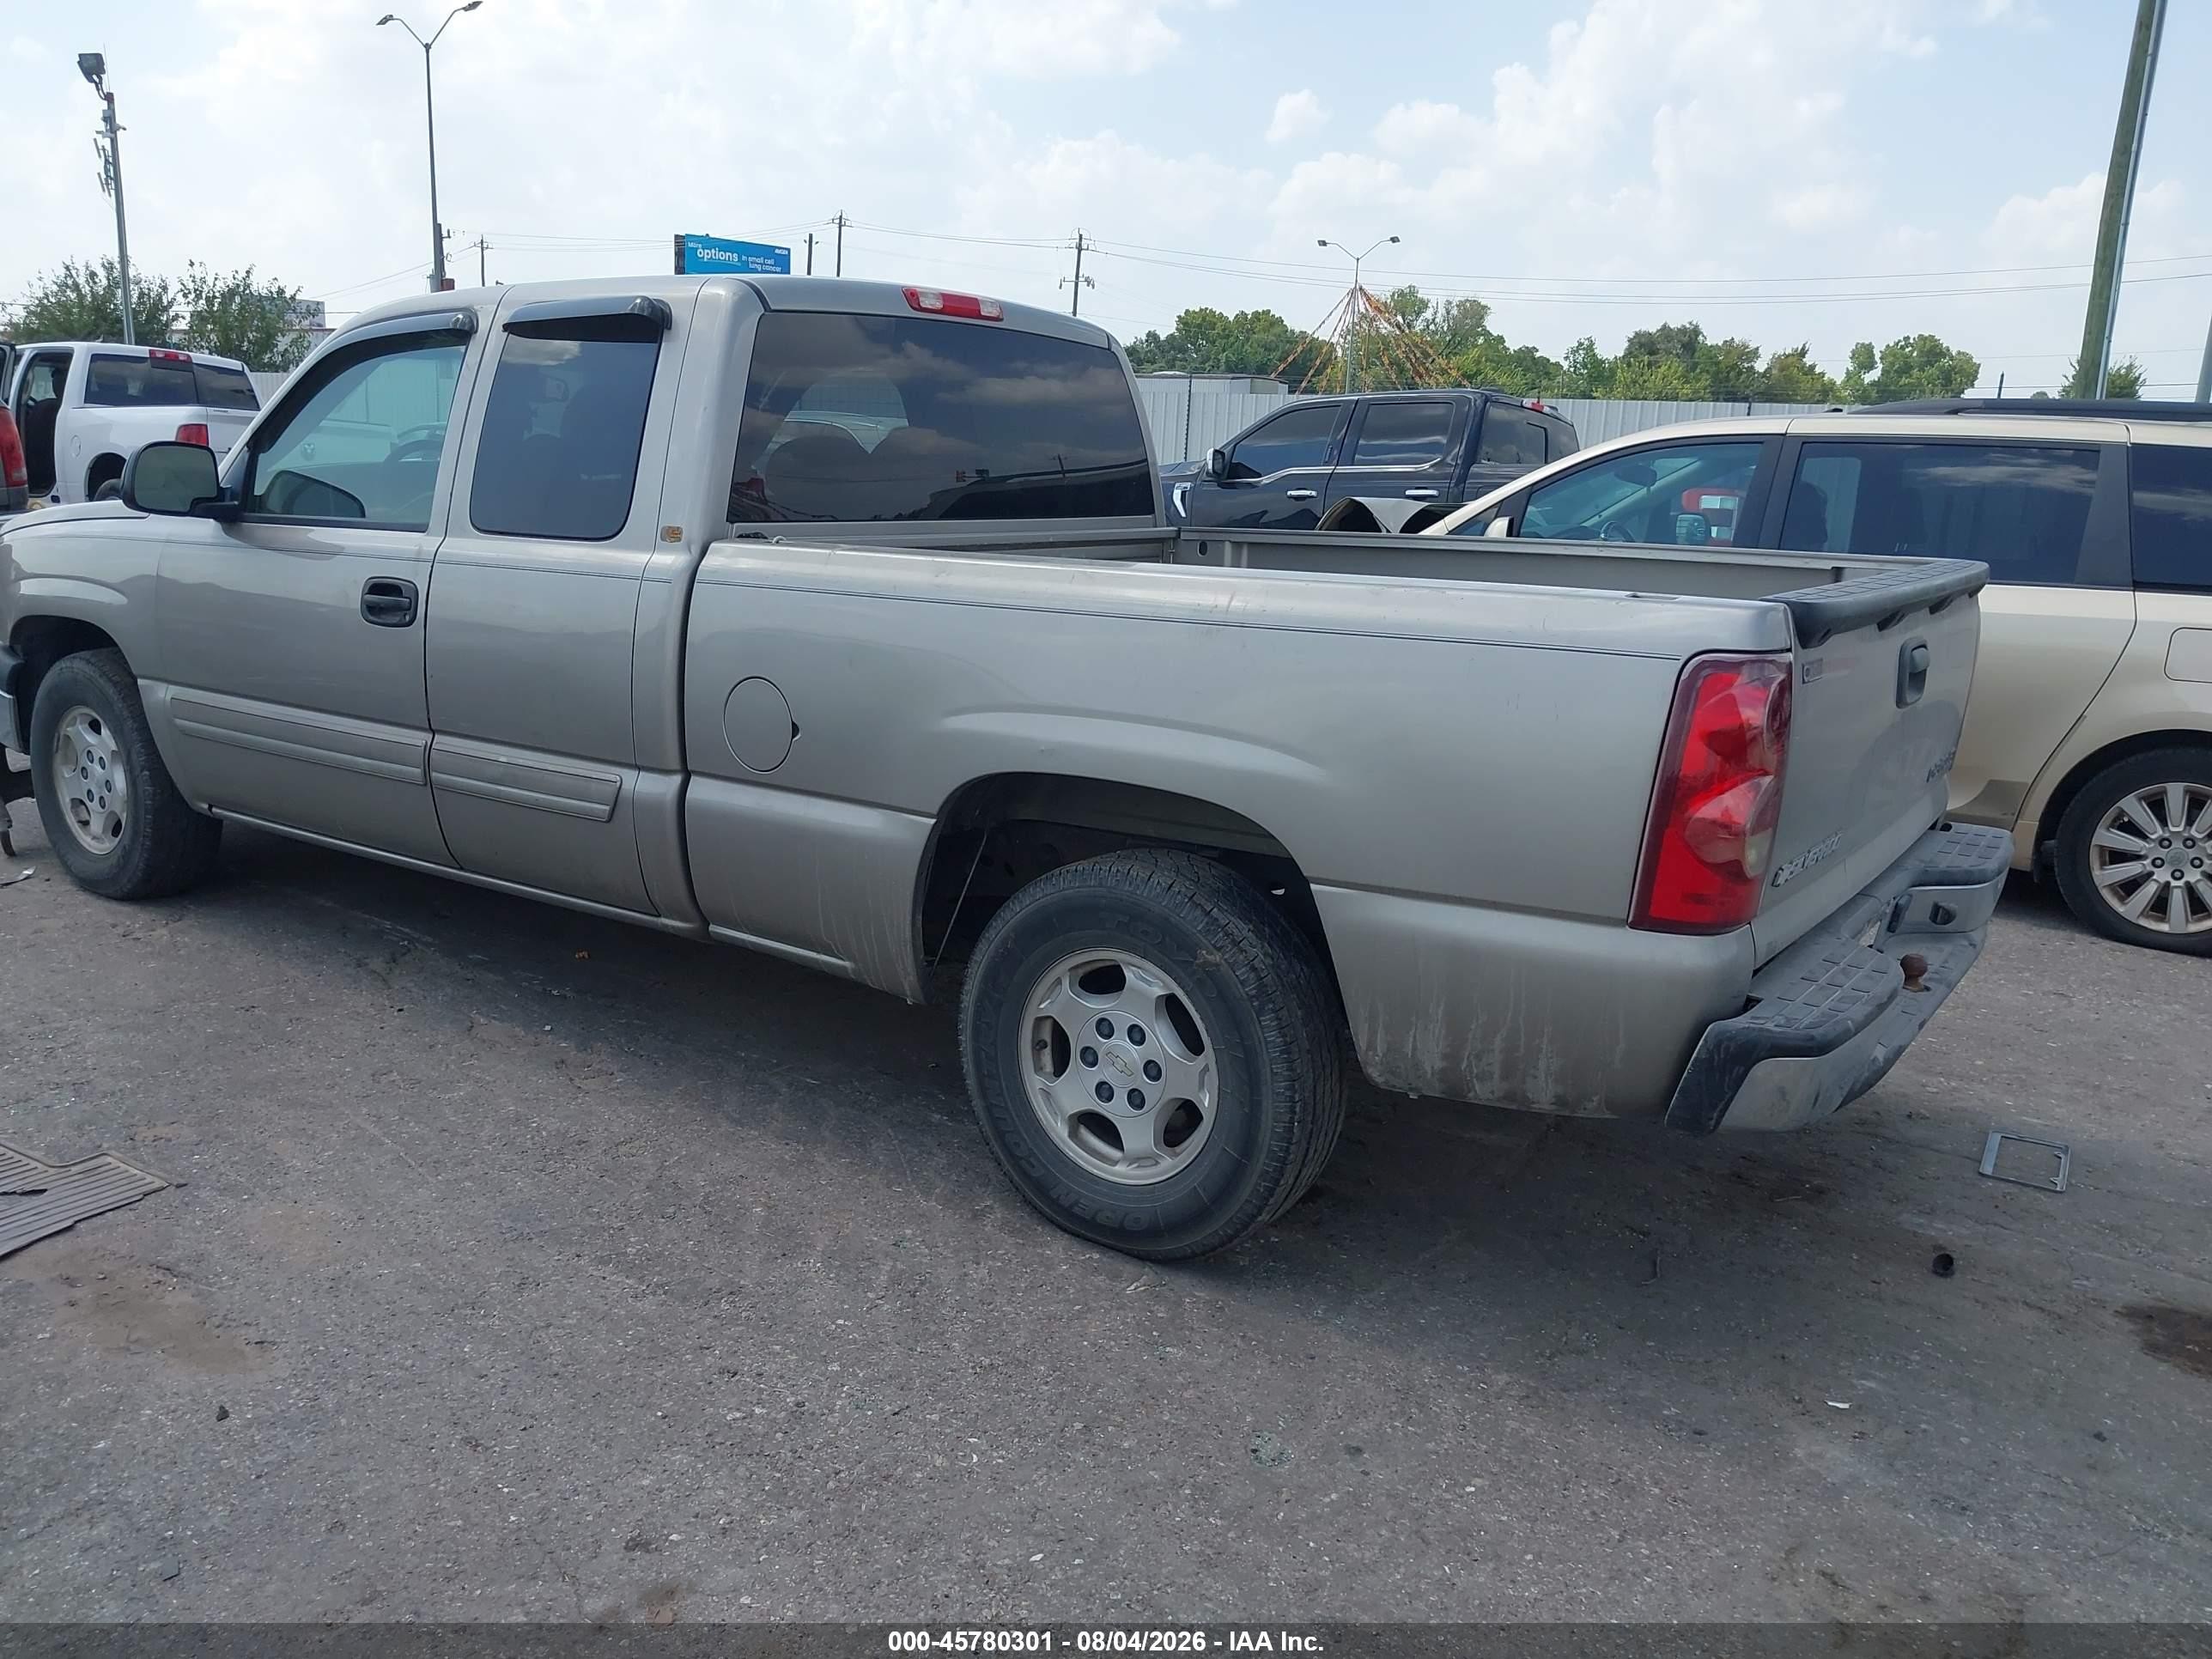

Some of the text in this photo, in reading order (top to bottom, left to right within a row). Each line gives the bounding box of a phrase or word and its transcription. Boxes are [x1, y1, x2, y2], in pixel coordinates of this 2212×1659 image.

[696, 247, 738, 262] options
[748, 256, 764, 264] small
[749, 261, 782, 273] lung cancer
